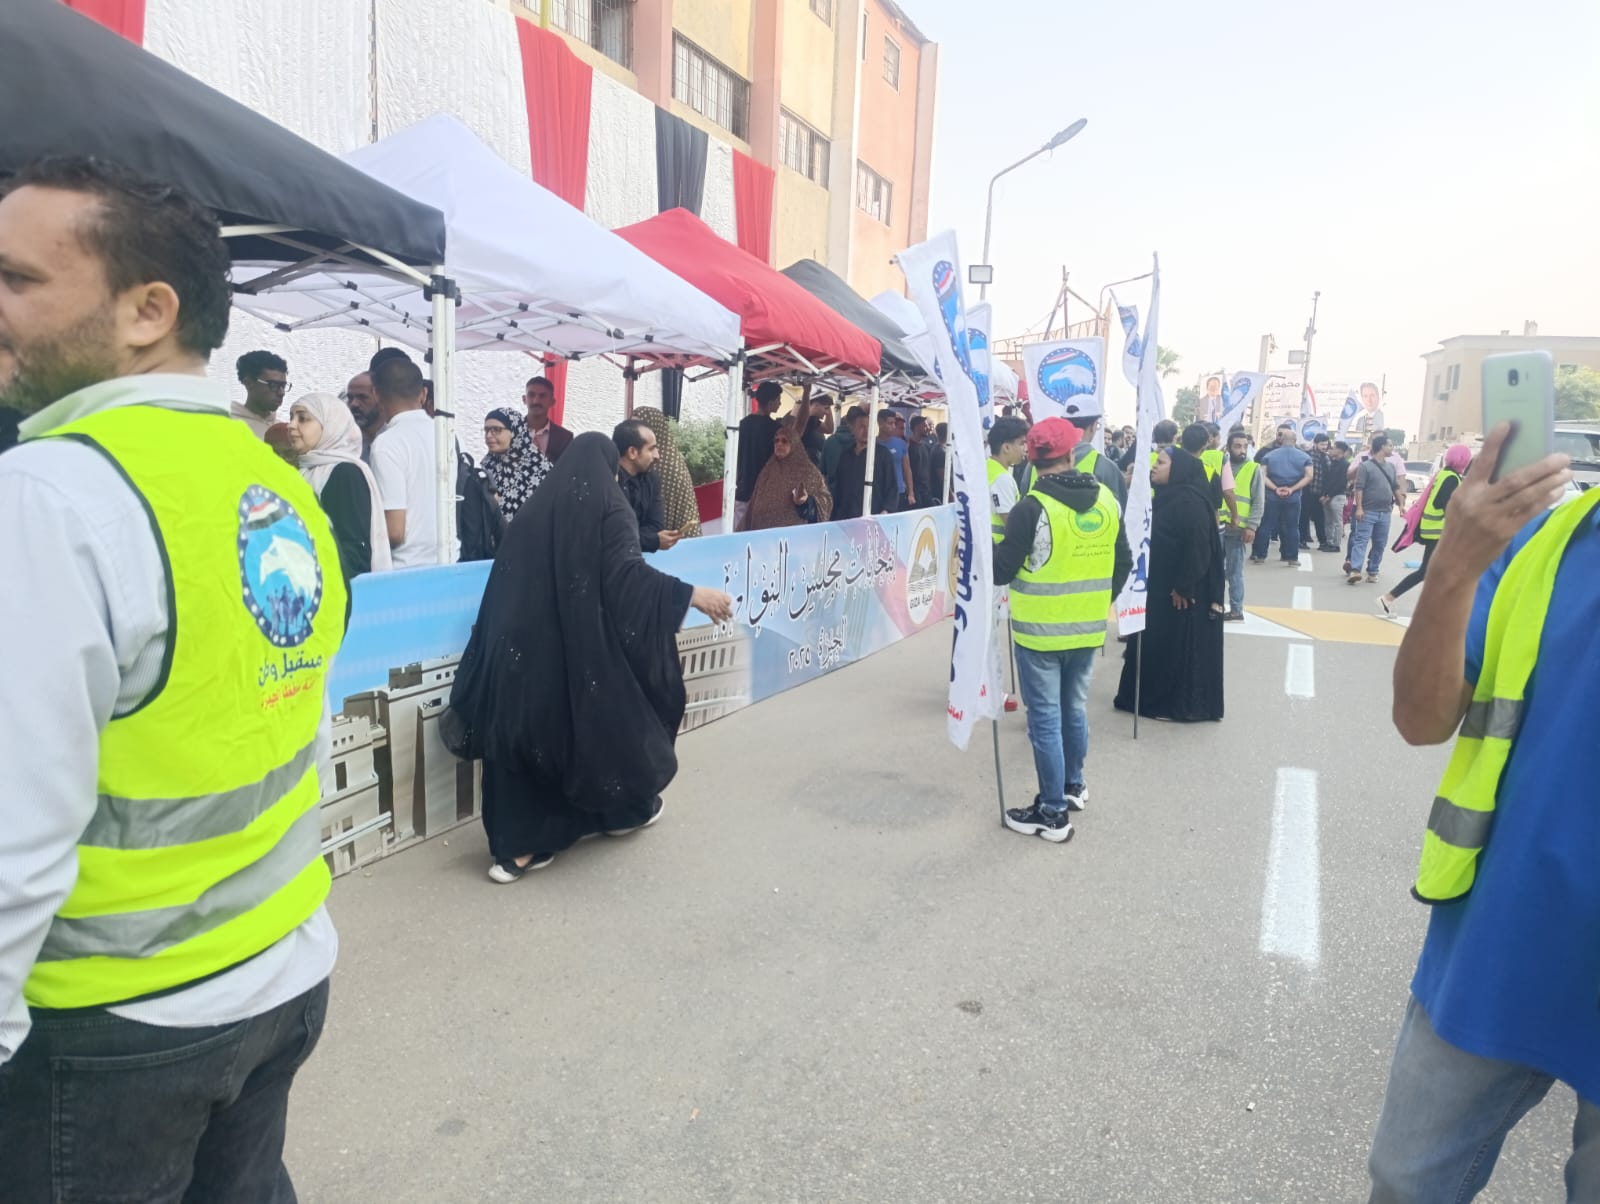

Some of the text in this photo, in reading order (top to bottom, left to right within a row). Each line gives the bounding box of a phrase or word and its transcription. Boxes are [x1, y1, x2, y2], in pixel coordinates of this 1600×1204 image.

[789, 532, 842, 619] مجلس
[845, 524, 899, 588] انتخابات
[258, 650, 322, 687] مستقبل وطن
[818, 617, 848, 668] الجيزة
